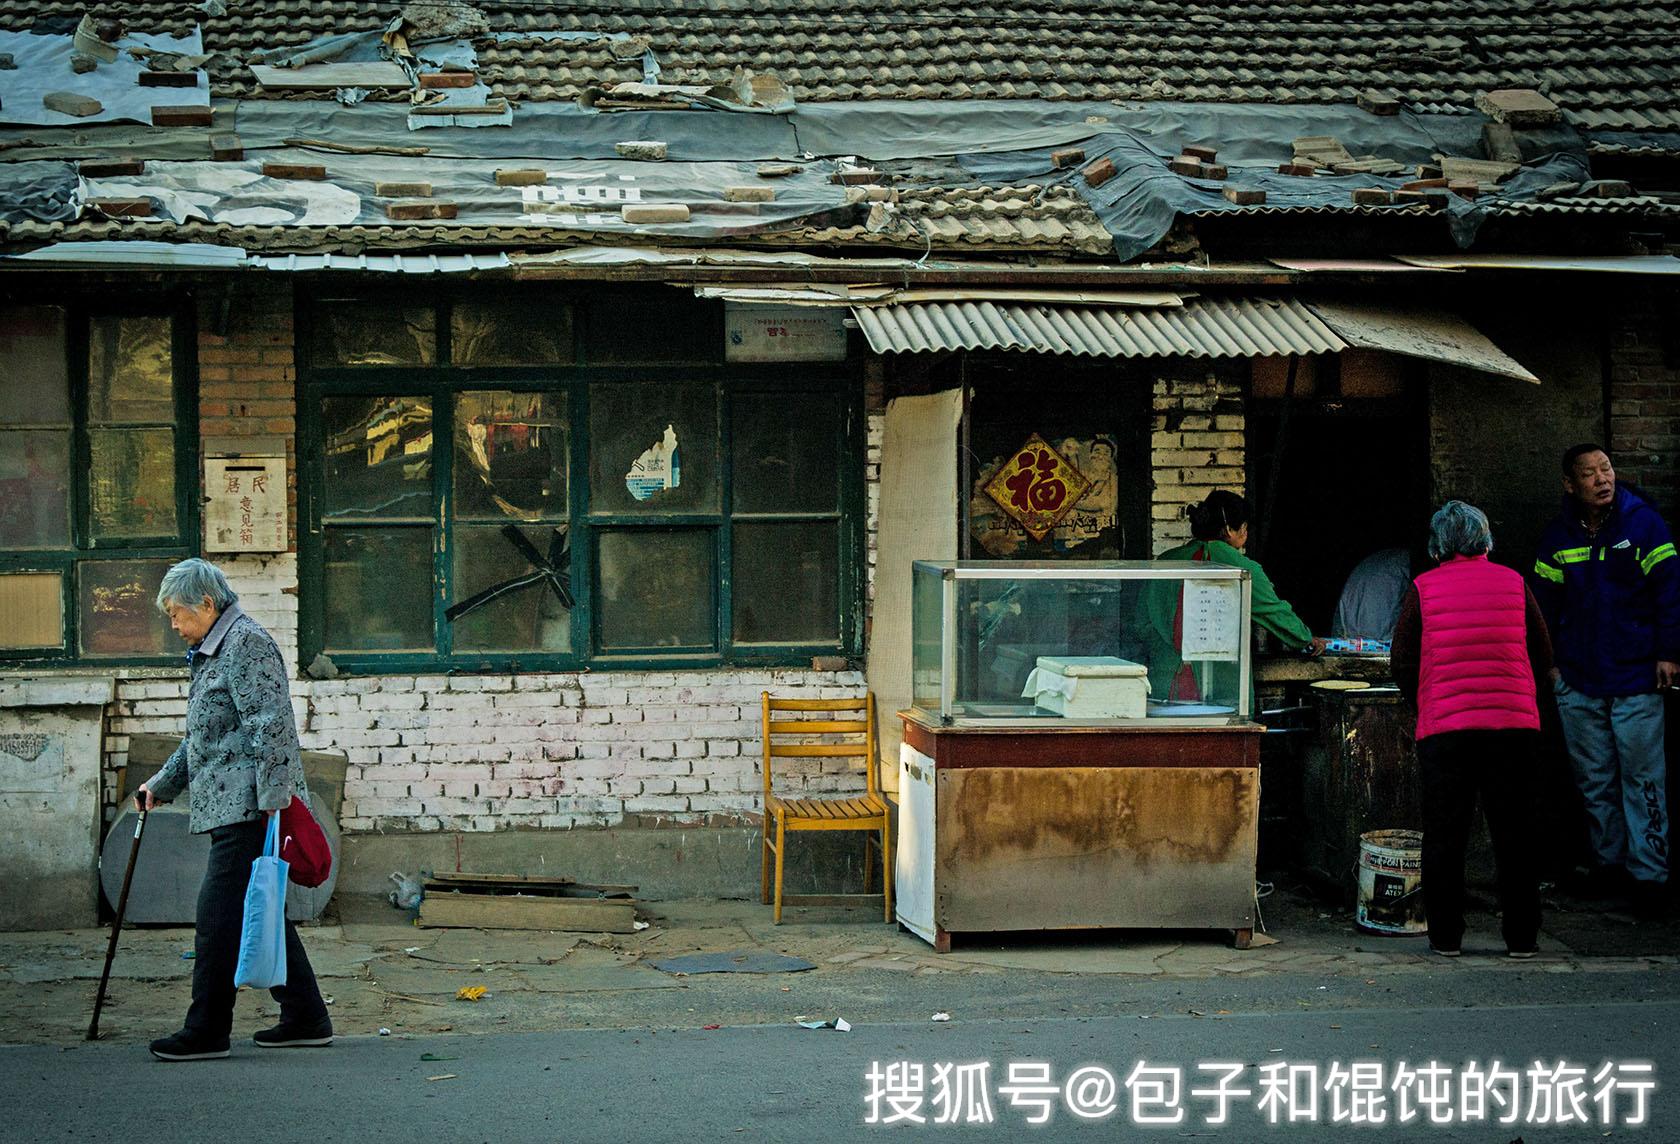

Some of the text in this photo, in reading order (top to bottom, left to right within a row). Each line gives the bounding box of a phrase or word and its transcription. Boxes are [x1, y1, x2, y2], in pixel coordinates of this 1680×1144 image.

[225, 477, 266, 494] 居民
[1005, 449, 1066, 512] 福
[239, 495, 254, 546] 意见箱
